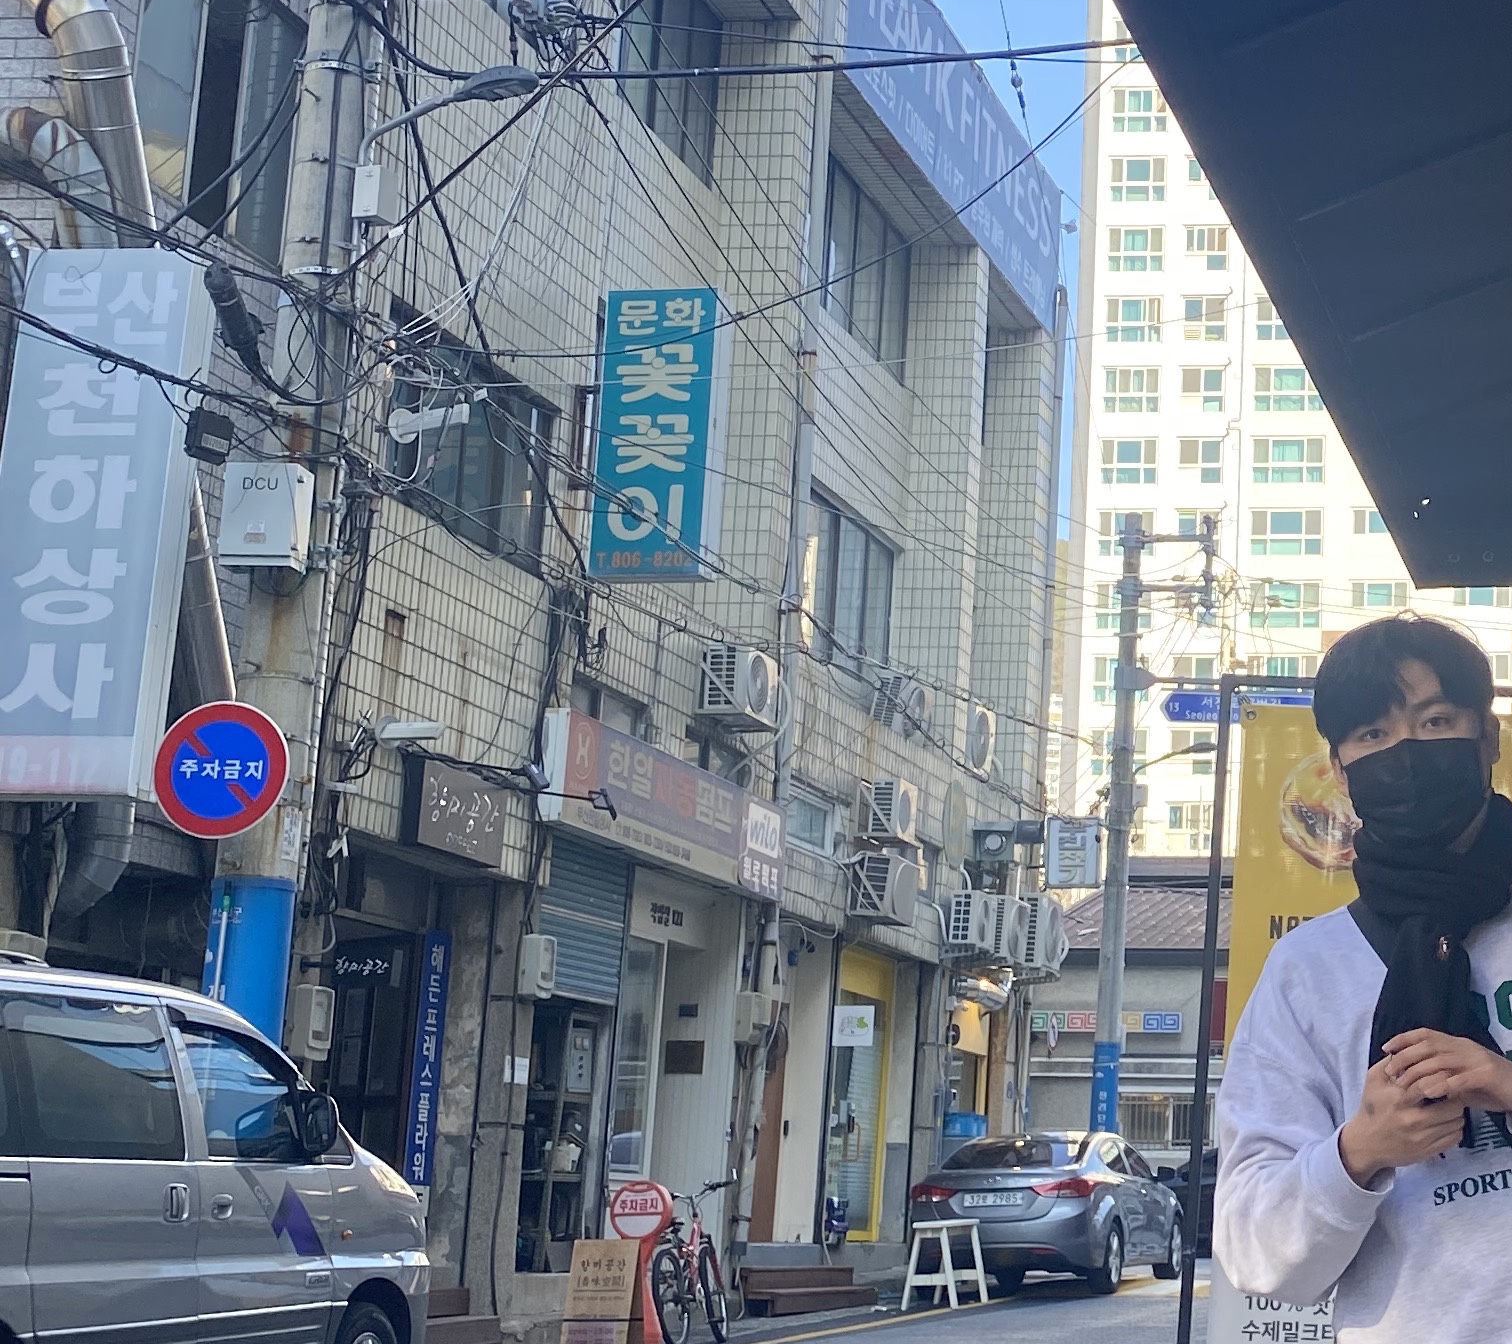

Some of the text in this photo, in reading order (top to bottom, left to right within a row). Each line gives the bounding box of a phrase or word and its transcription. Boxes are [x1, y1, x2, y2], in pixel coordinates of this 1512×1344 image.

[935, 36, 955, 134] K
[961, 77, 1051, 258] FITNESS
[617, 297, 706, 336] 문화
[242, 476, 279, 490] DCU
[0, 363, 141, 719] 천하상사
[1168, 702, 1180, 713] 13
[607, 739, 739, 833] 한일자동펌프
[750, 813, 778, 852] wilo
[1269, 915, 1316, 940] NA
[992, 1193, 1018, 1204] 2985
